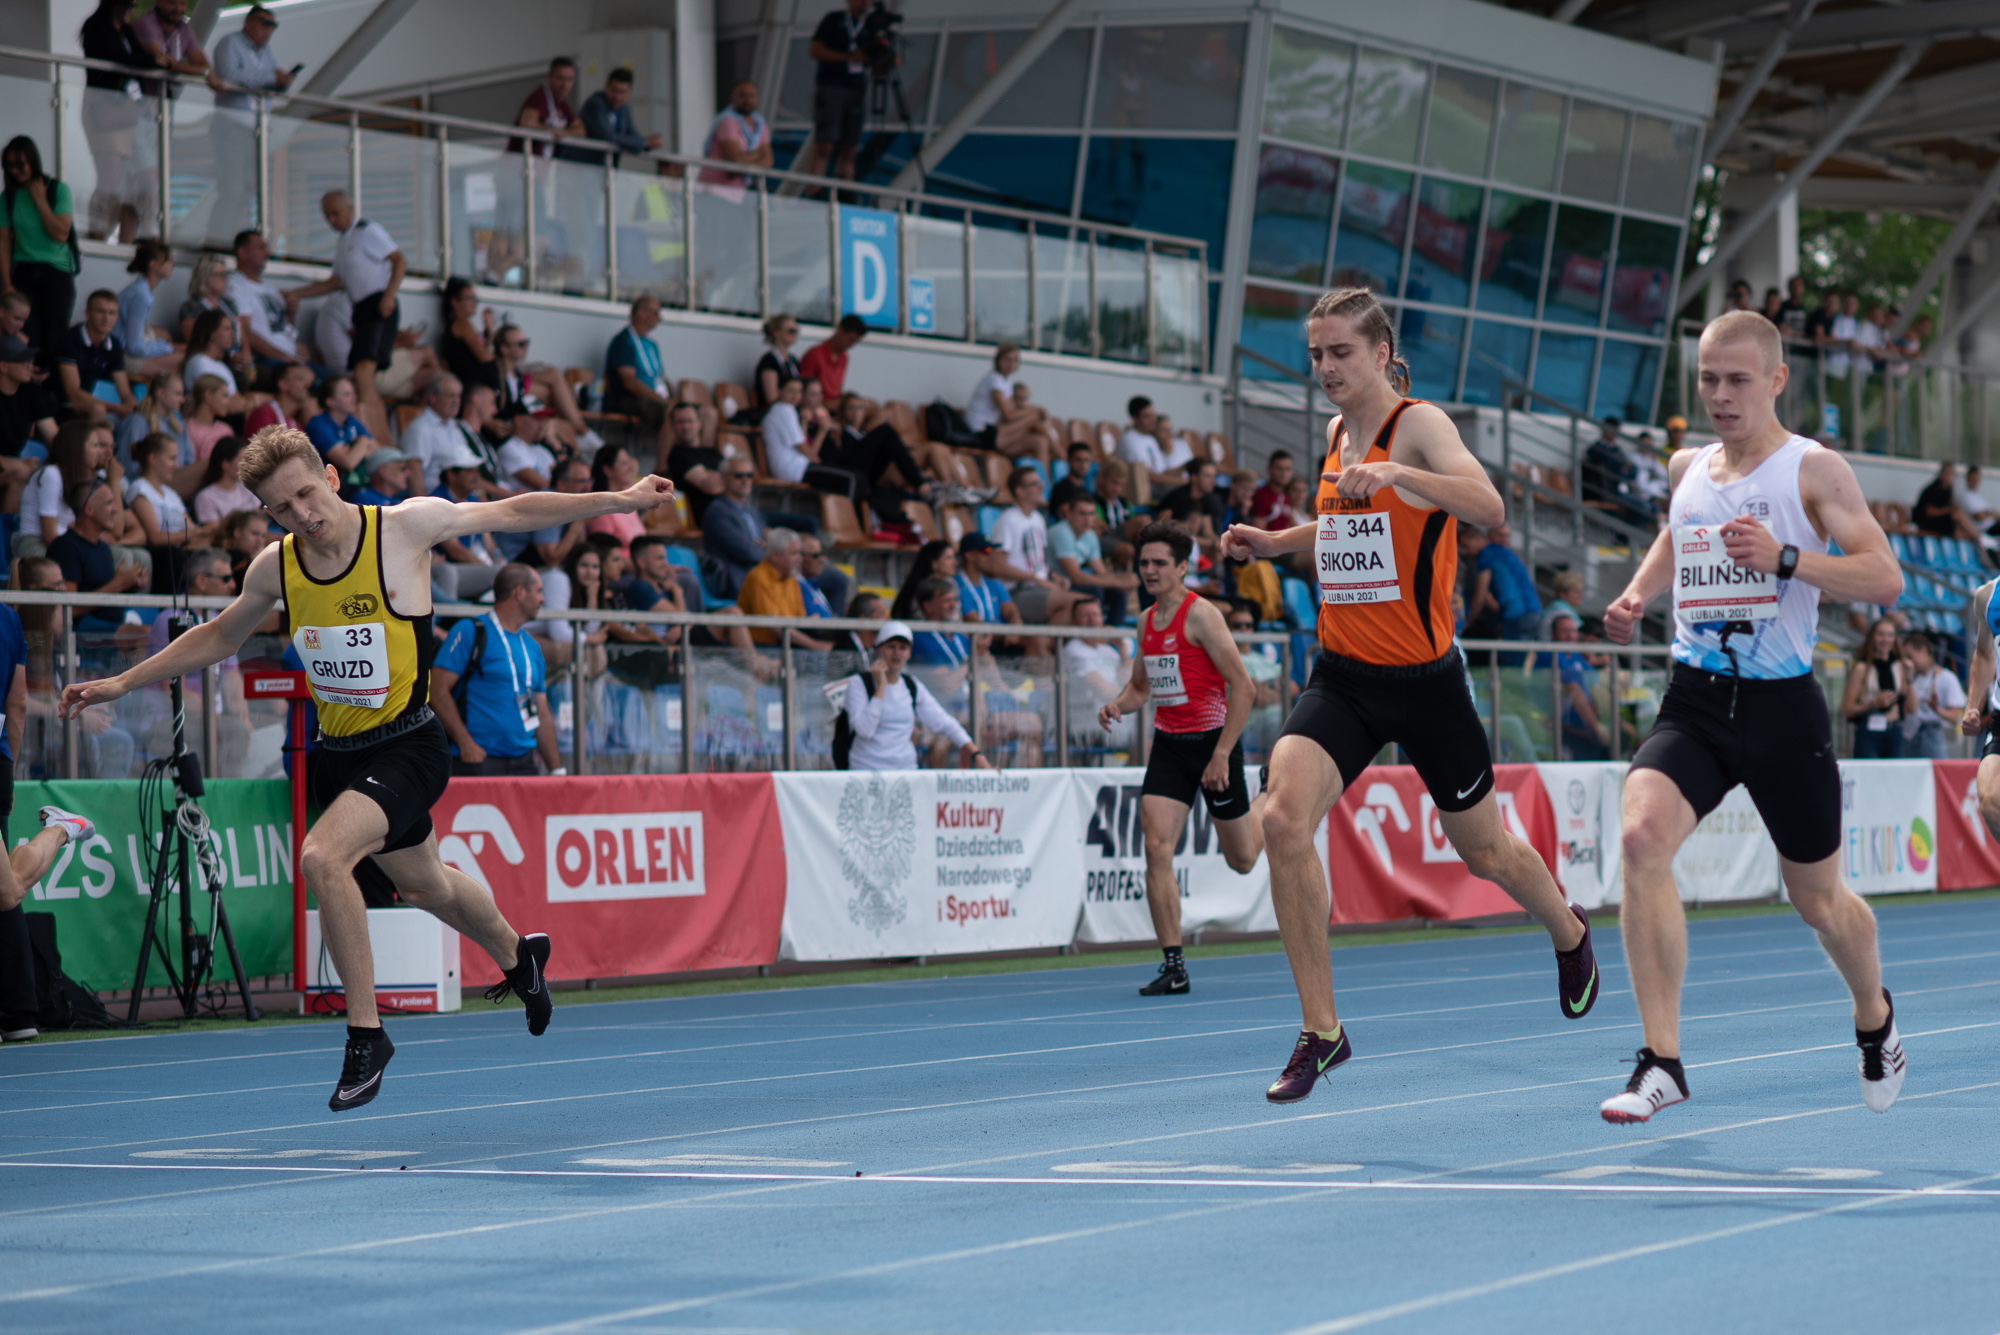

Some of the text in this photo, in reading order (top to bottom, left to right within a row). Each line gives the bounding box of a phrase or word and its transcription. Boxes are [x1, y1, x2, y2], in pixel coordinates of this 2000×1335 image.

[852, 240, 887, 315] D
[910, 284, 932, 309] WC
[1347, 517, 1384, 537] 344
[1683, 544, 1709, 552] ORLEN
[1321, 551, 1384, 571] SIKORA
[1328, 591, 1378, 602] LUBLIN 2021
[346, 602, 371, 616] OSA
[1690, 607, 1753, 620] LUBLIN 2021
[345, 627, 372, 647] 33
[312, 660, 374, 678] GRUZD
[1158, 657, 1175, 668] 479
[328, 694, 372, 706] LUBLIN 2021
[323, 735, 352, 748] NIKE
[352, 728, 380, 745] PRO
[384, 711, 422, 736] NIKE
[936, 772, 1030, 794] Ministerstwo
[936, 800, 1004, 833] Kultury
[936, 834, 1024, 858] Dziedzictwa
[1871, 824, 1904, 876] KIDS
[555, 826, 695, 889] ORLEN
[936, 864, 1032, 889] Narodowego
[1087, 866, 1190, 902] PROFESAL
[937, 900, 943, 922] i
